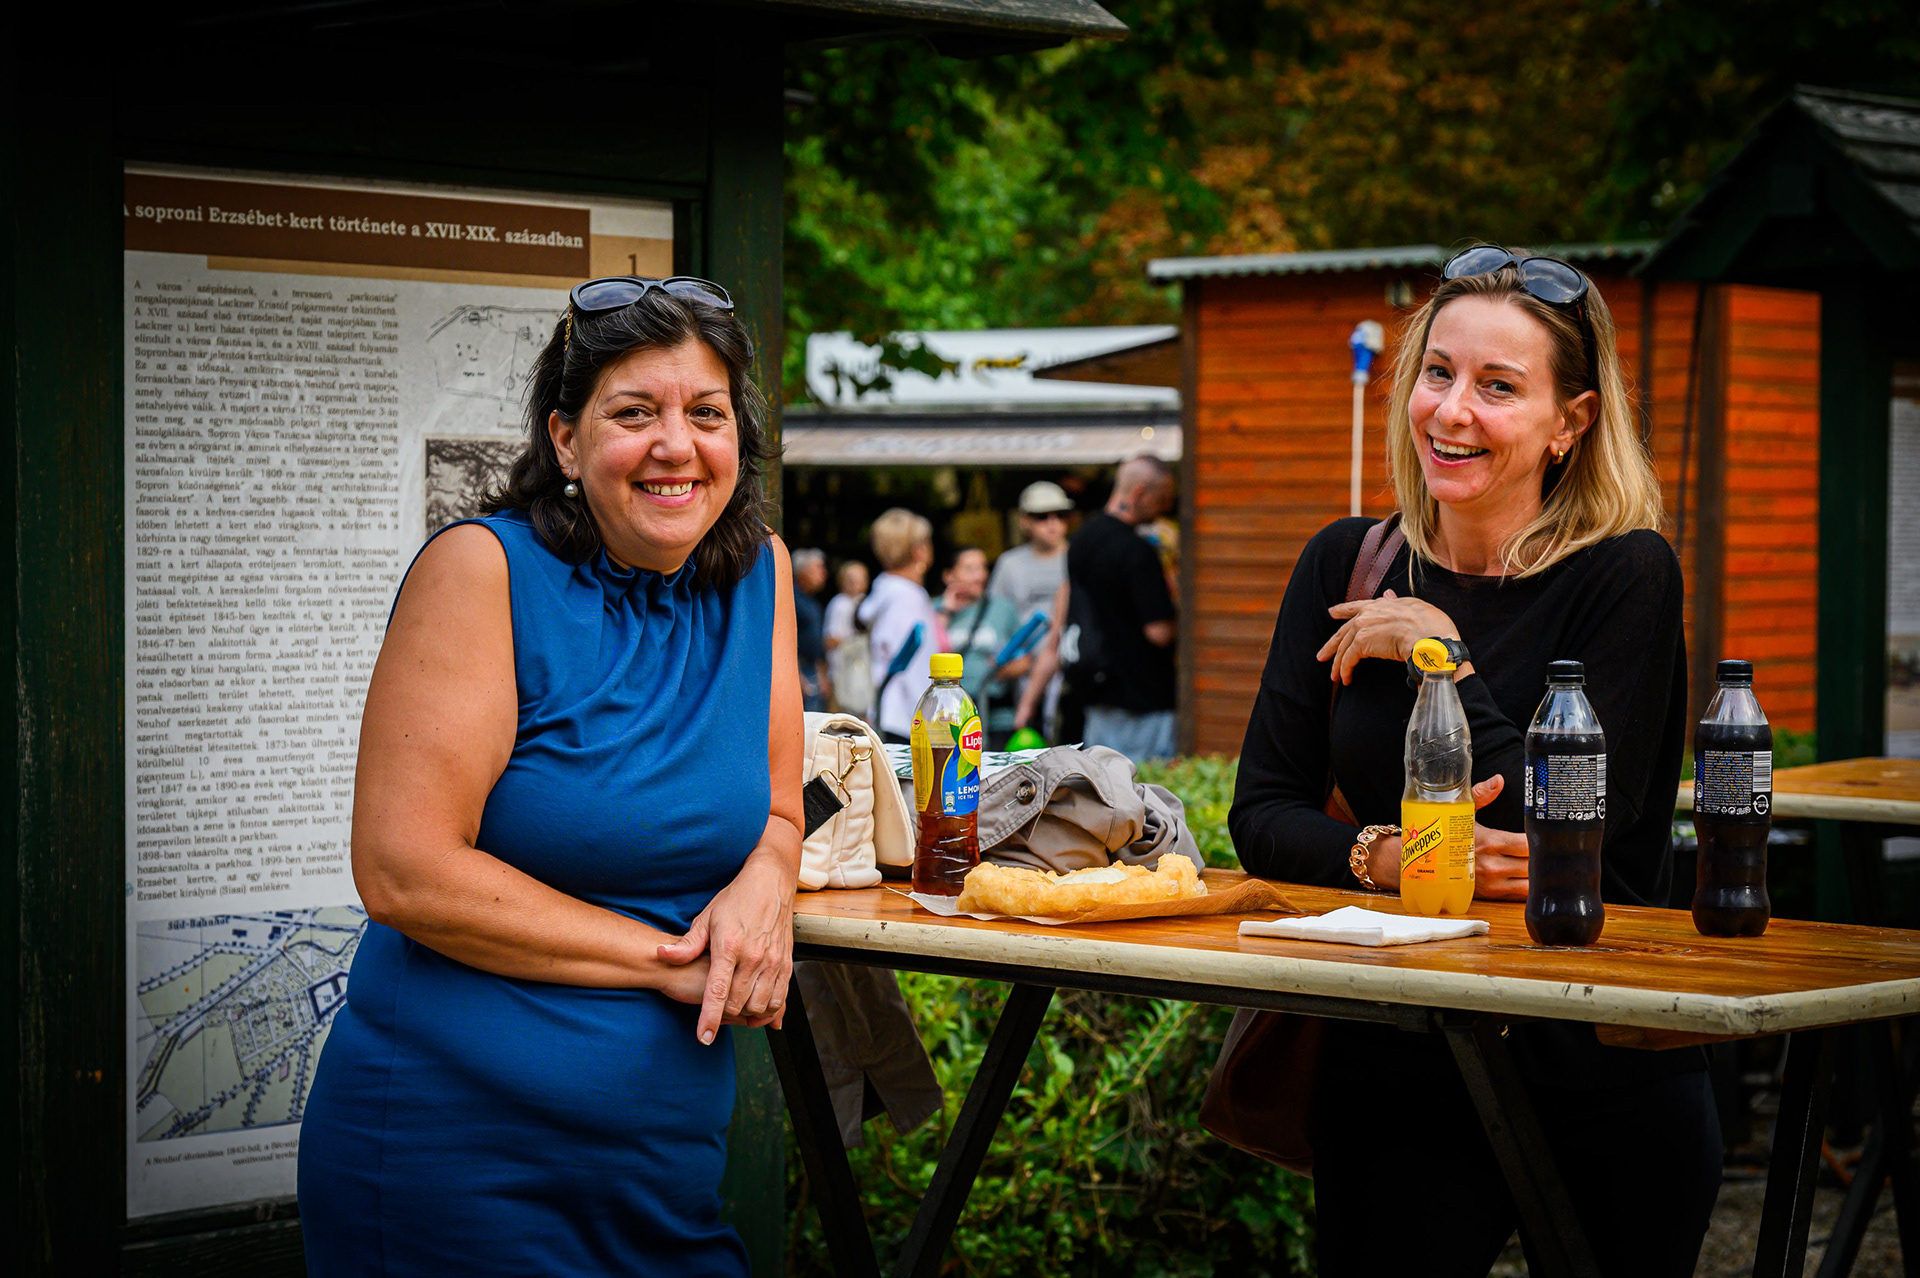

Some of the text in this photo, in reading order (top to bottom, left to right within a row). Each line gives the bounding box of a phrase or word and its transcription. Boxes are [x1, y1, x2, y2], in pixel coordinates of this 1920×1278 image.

[135, 205, 203, 223] soproni
[208, 206, 325, 230] Erzsébet-kert
[329, 216, 407, 236] története
[411, 224, 421, 237] a
[425, 222, 501, 243] XVII-XIX.
[505, 229, 584, 249] században
[627, 252, 638, 275] 1
